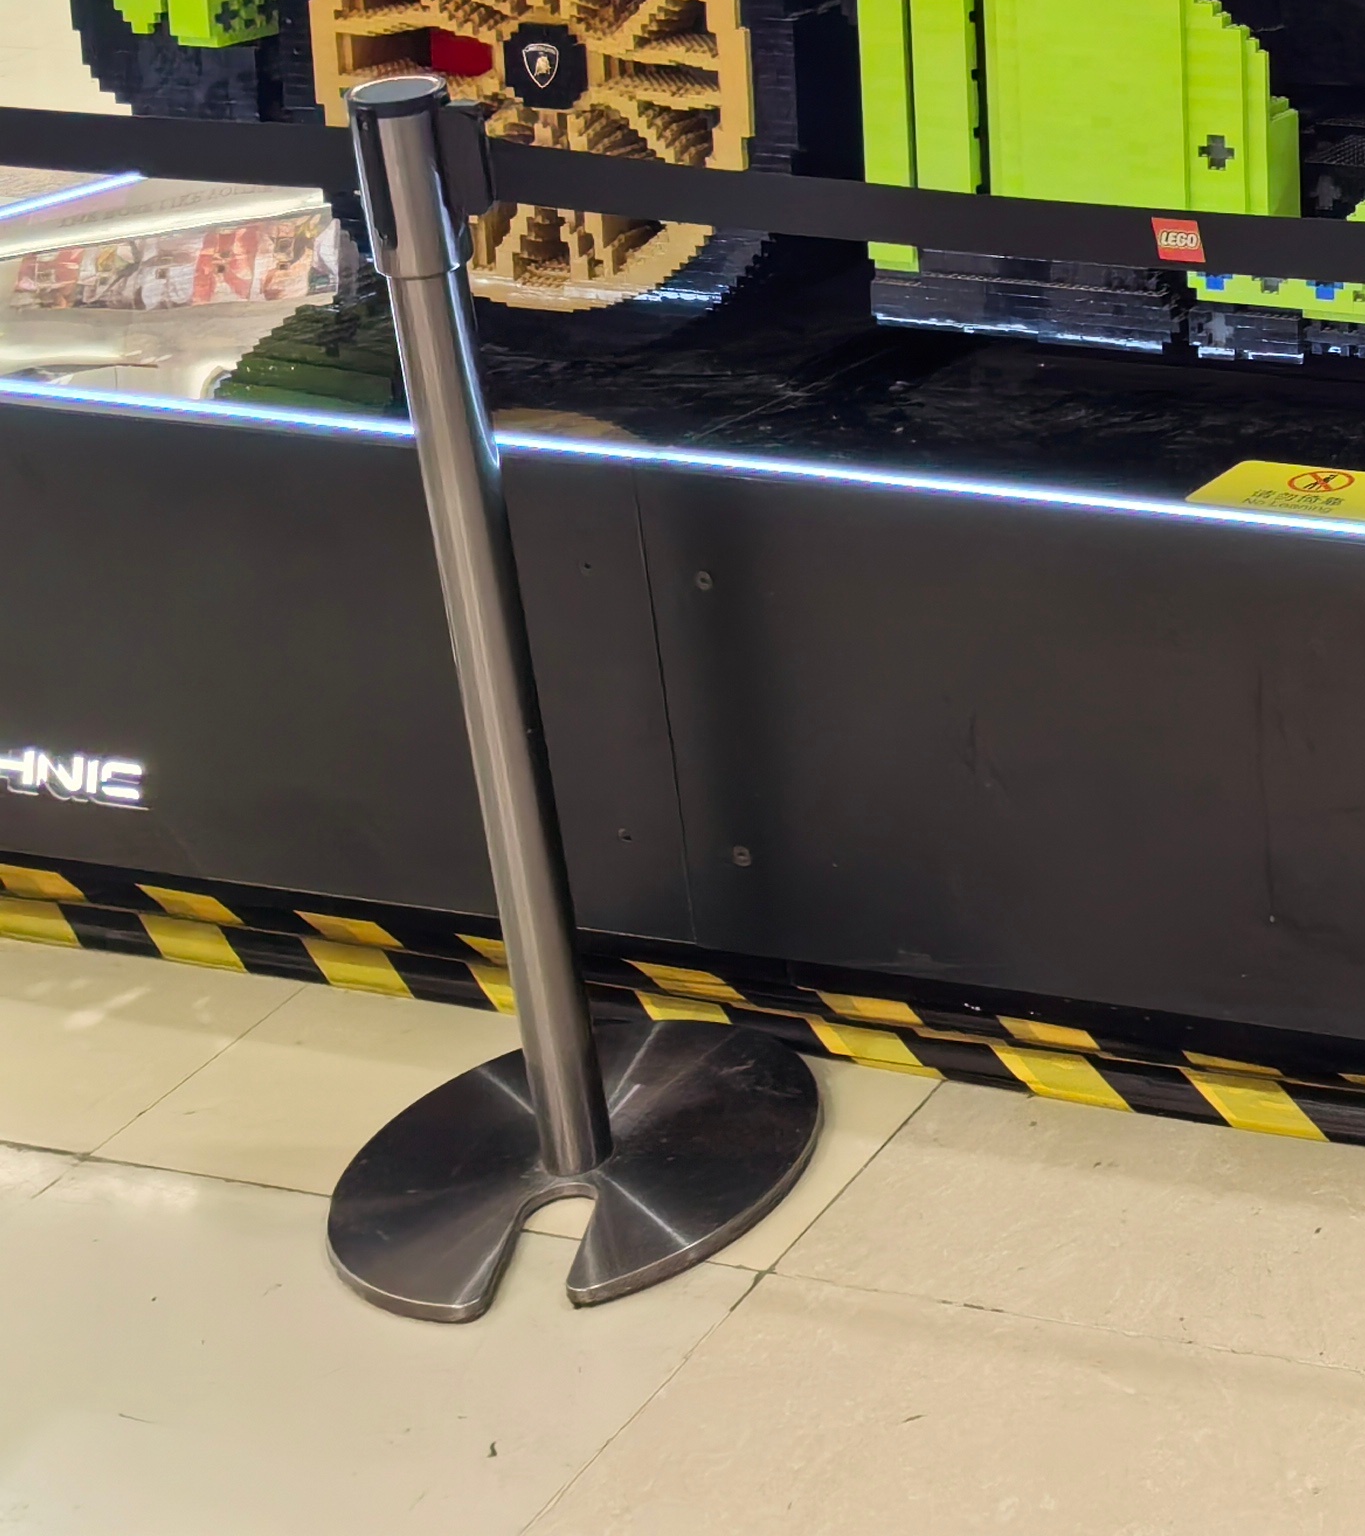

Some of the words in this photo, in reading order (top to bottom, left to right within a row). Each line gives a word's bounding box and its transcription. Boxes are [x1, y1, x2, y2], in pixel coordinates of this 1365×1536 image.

[1160, 231, 1198, 248] LEGO
[1243, 497, 1265, 506] No
[1270, 498, 1333, 514] Leaning
